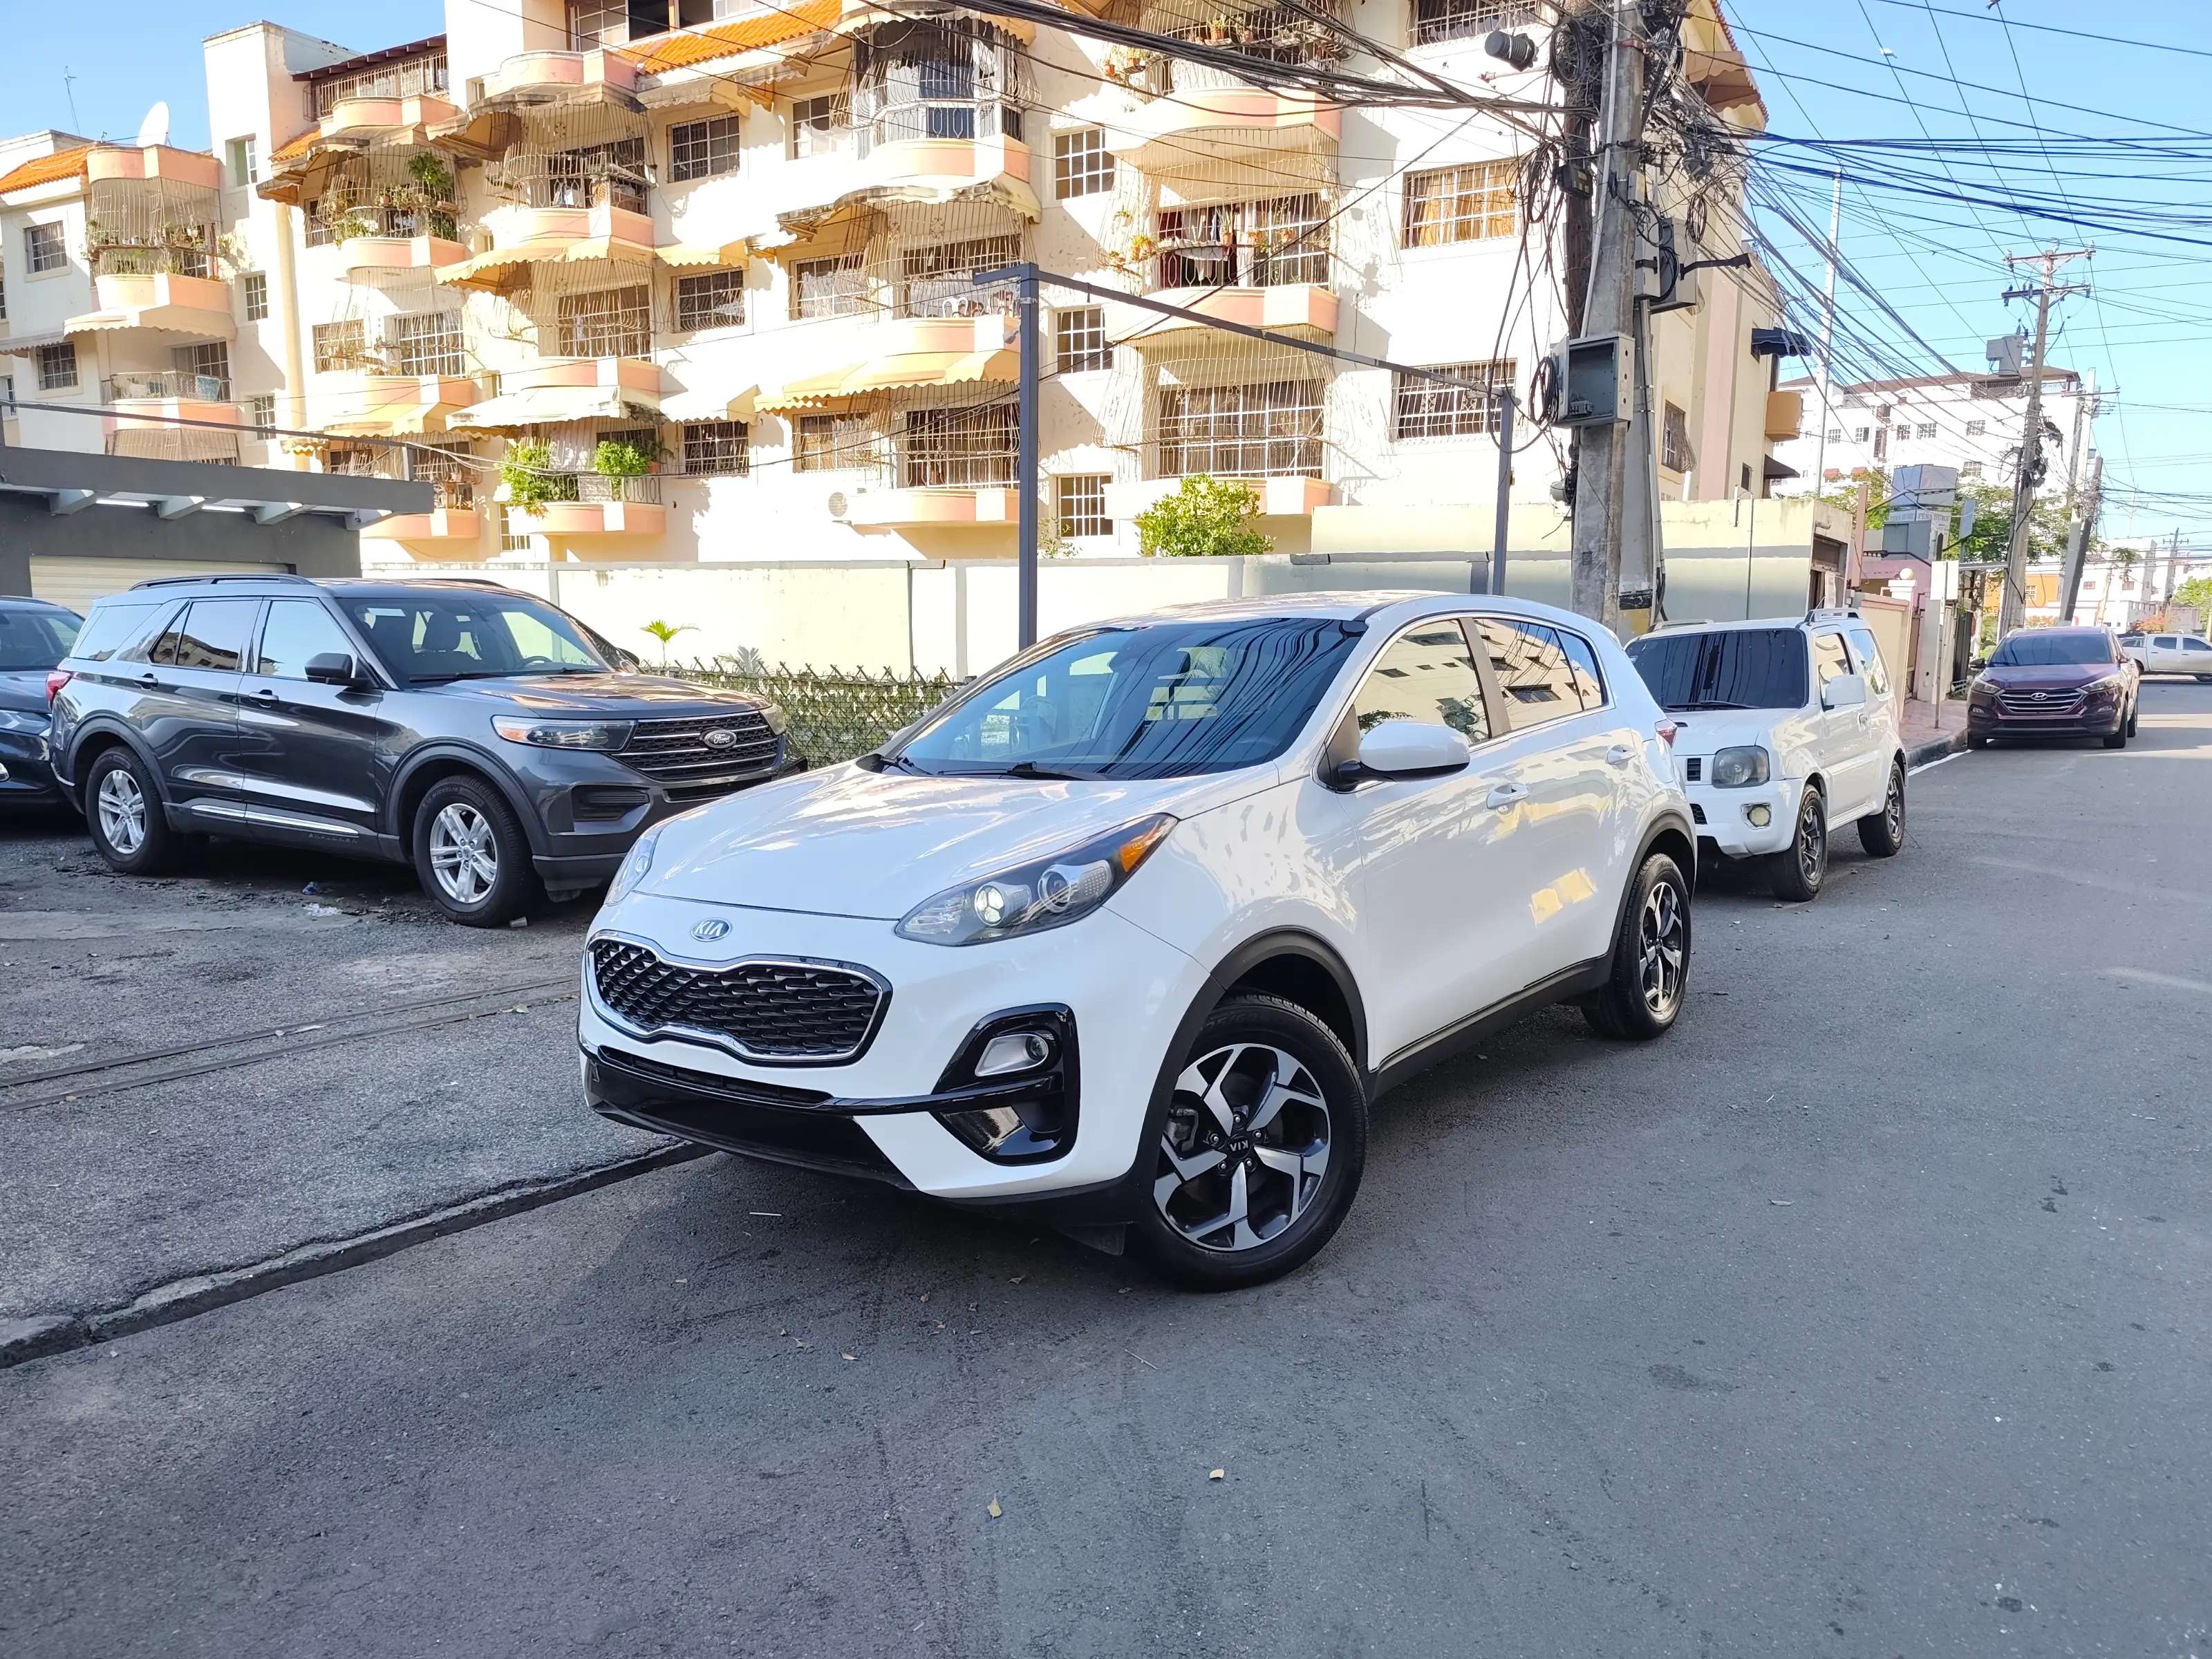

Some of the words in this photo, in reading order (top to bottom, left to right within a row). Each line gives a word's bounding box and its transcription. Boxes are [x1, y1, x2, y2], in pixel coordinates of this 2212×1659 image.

[713, 733, 731, 744] Ford
[694, 921, 724, 937] KIA
[1229, 1139, 1249, 1152] KIA
